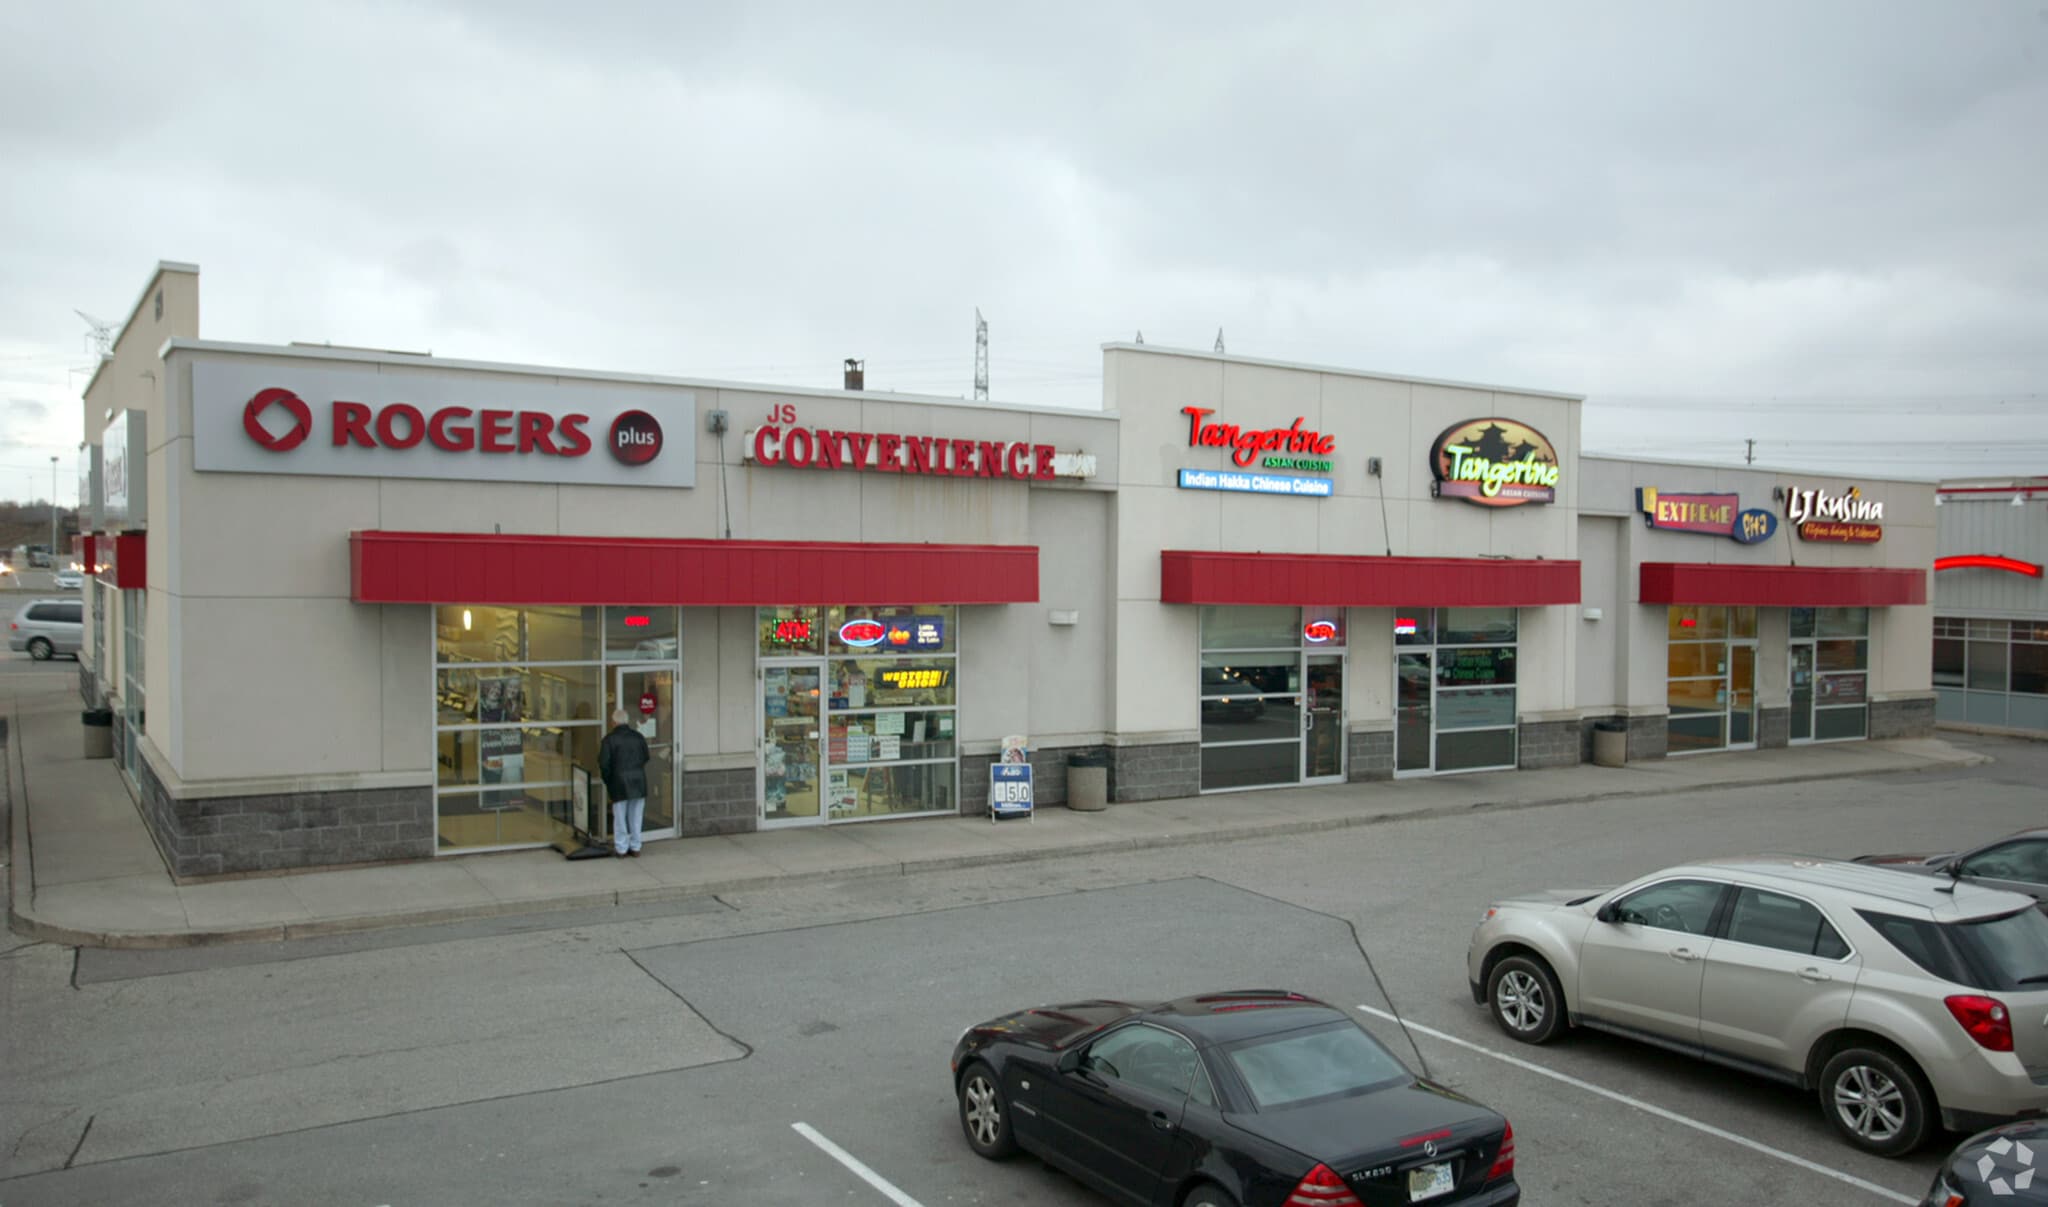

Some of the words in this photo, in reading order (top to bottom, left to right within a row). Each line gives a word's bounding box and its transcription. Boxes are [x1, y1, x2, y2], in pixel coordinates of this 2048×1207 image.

[767, 404, 796, 424] JS
[333, 401, 592, 457] ROGERS
[618, 427, 655, 448] plus
[754, 425, 1056, 480] CONVENIENCE
[1264, 456, 1294, 469] ASIAN
[1185, 472, 1217, 487] Indian
[1219, 475, 1250, 489] Hakka
[1252, 477, 1291, 492] Chinese
[1293, 479, 1329, 494] Cuisine
[1789, 486, 1814, 524] LJ
[776, 621, 810, 640] ATM
[842, 623, 886, 641] OPEN
[1305, 624, 1335, 640] OPEN
[882, 670, 939, 682] WESTERN
[898, 679, 937, 689] UNION
